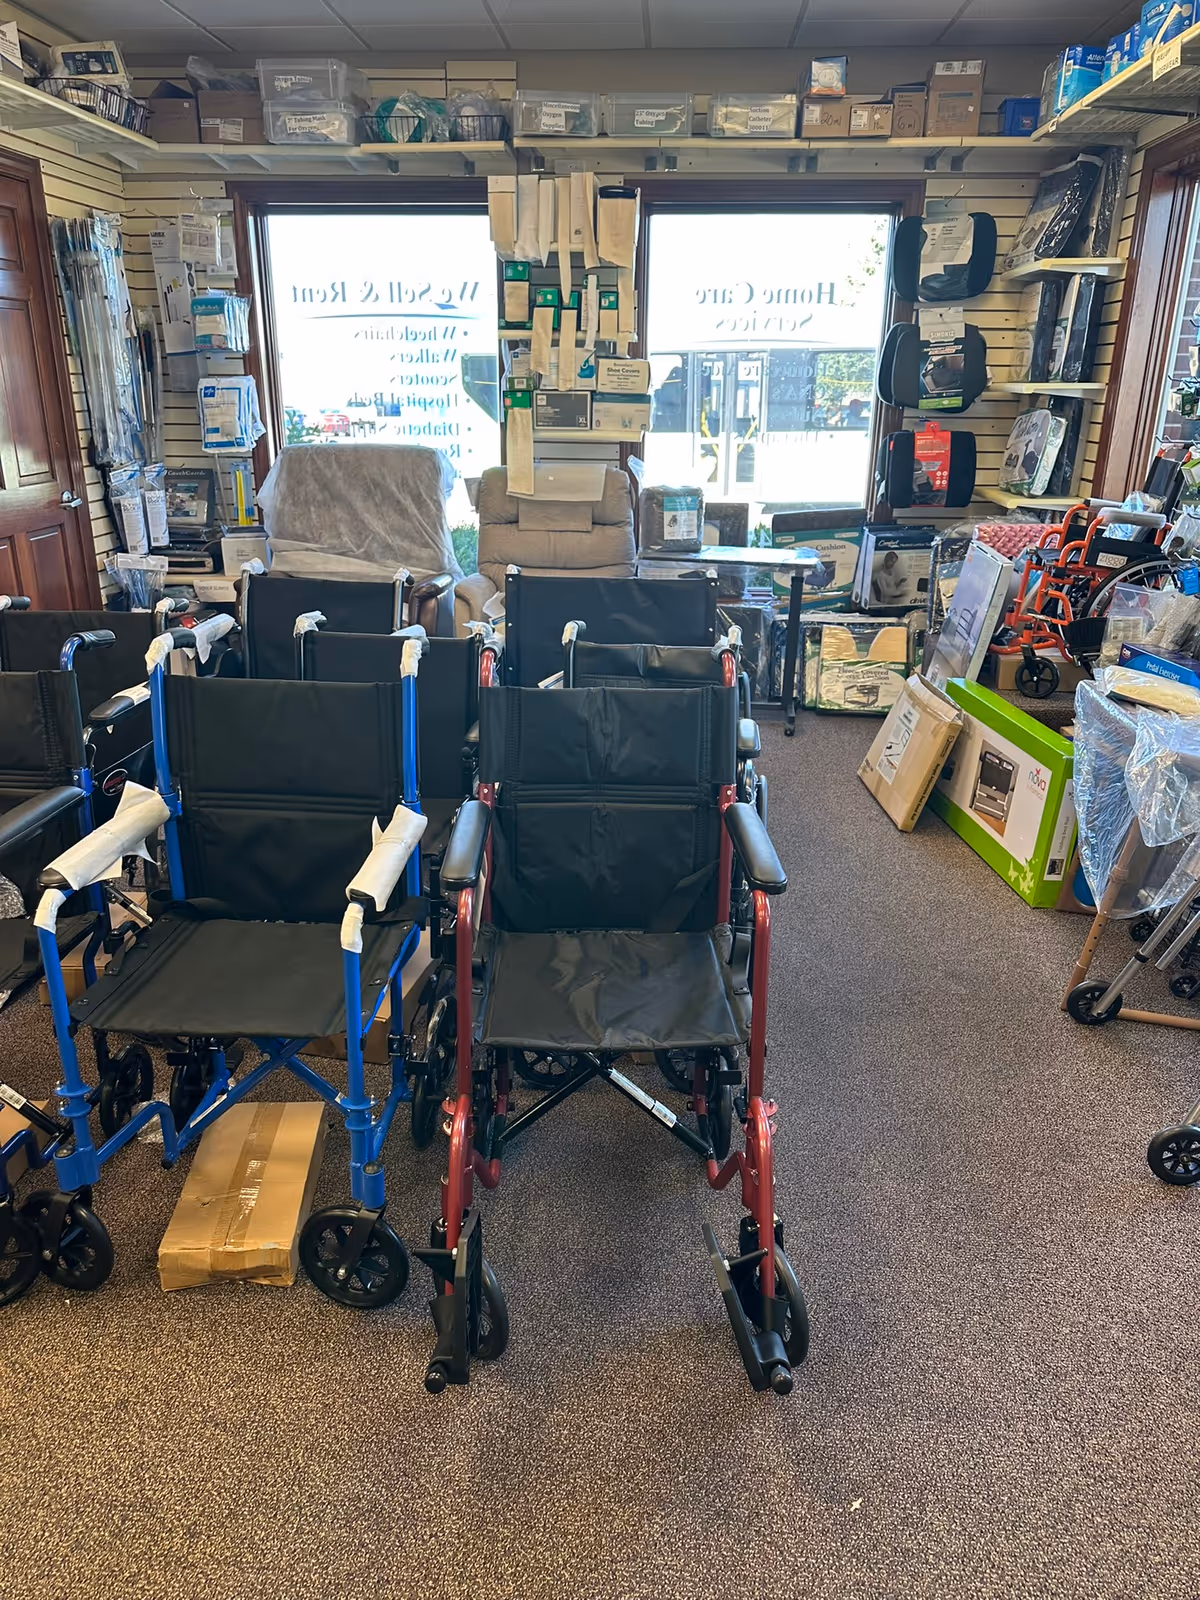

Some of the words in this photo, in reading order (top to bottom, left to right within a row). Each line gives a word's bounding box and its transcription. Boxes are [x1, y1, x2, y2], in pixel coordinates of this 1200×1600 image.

[1099, 554, 1126, 566] ziggo
[909, 597, 928, 605] drive
[1146, 661, 1160, 673] Pedal
[1159, 666, 1181, 682] Exerciser
[1028, 770, 1046, 792] nova
